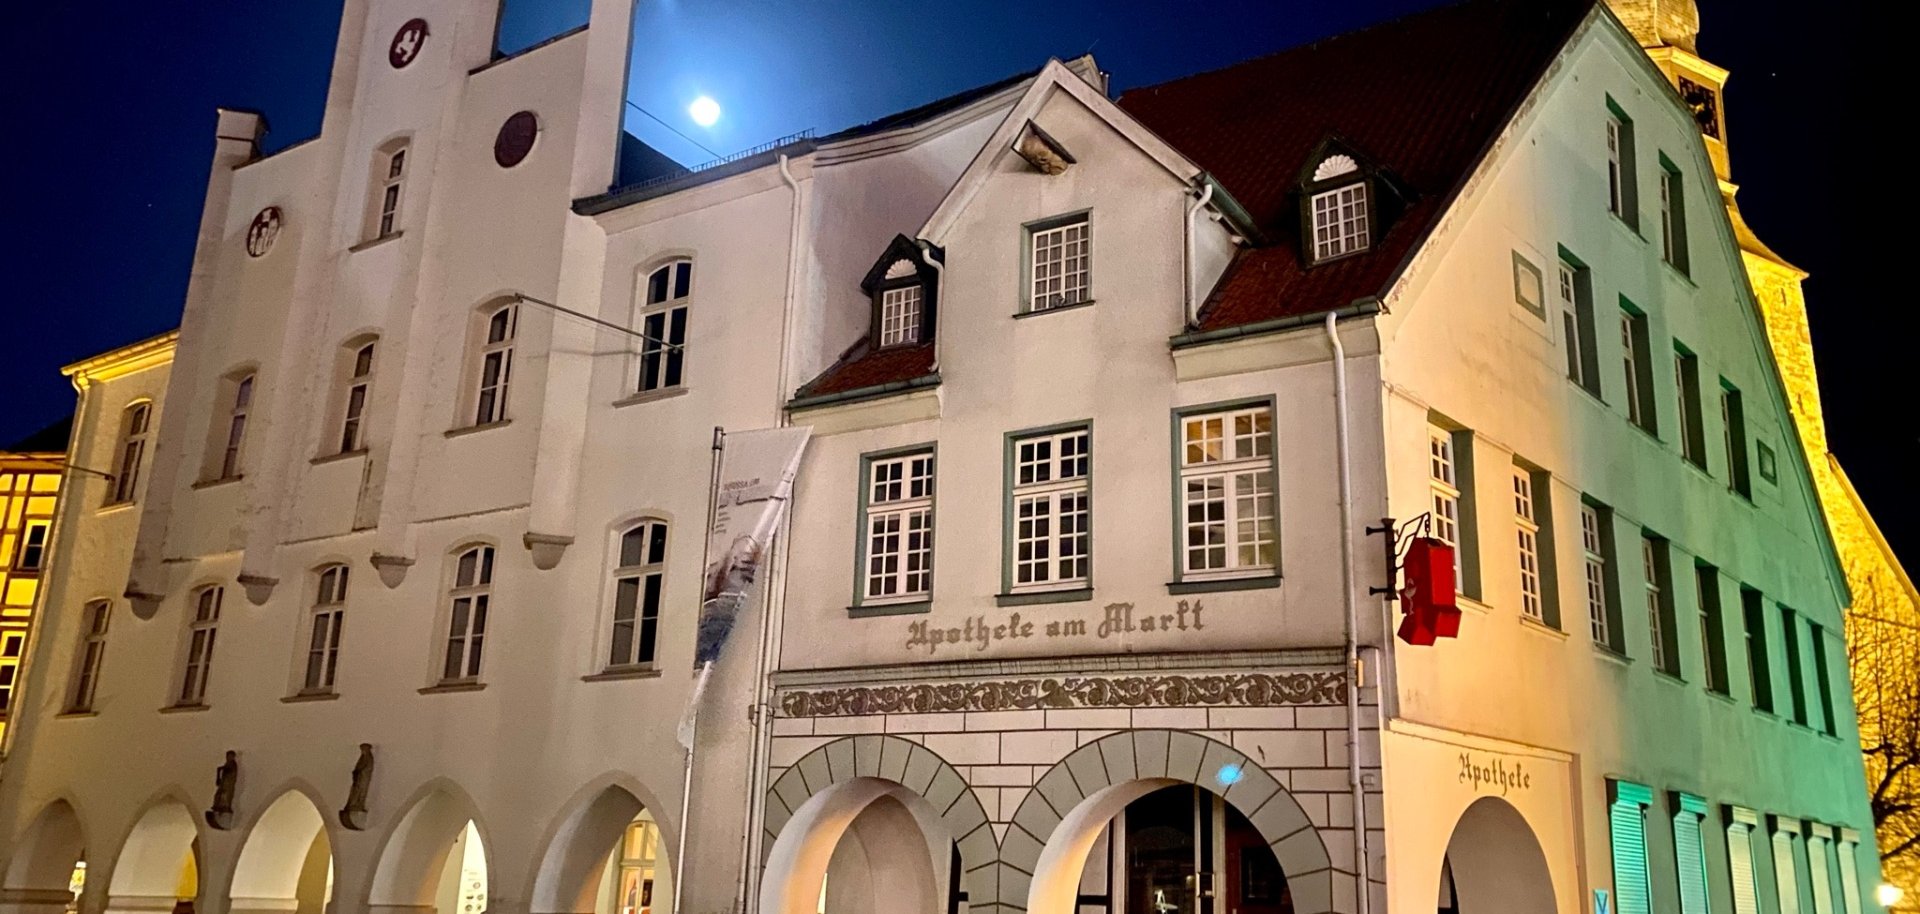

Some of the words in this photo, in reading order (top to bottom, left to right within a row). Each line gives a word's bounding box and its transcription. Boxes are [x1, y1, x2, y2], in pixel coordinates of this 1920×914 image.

[905, 611, 1034, 655] Apotheke
[1045, 616, 1087, 637] am
[1098, 599, 1204, 639] Markt
[1459, 752, 1530, 797] Apotheke
